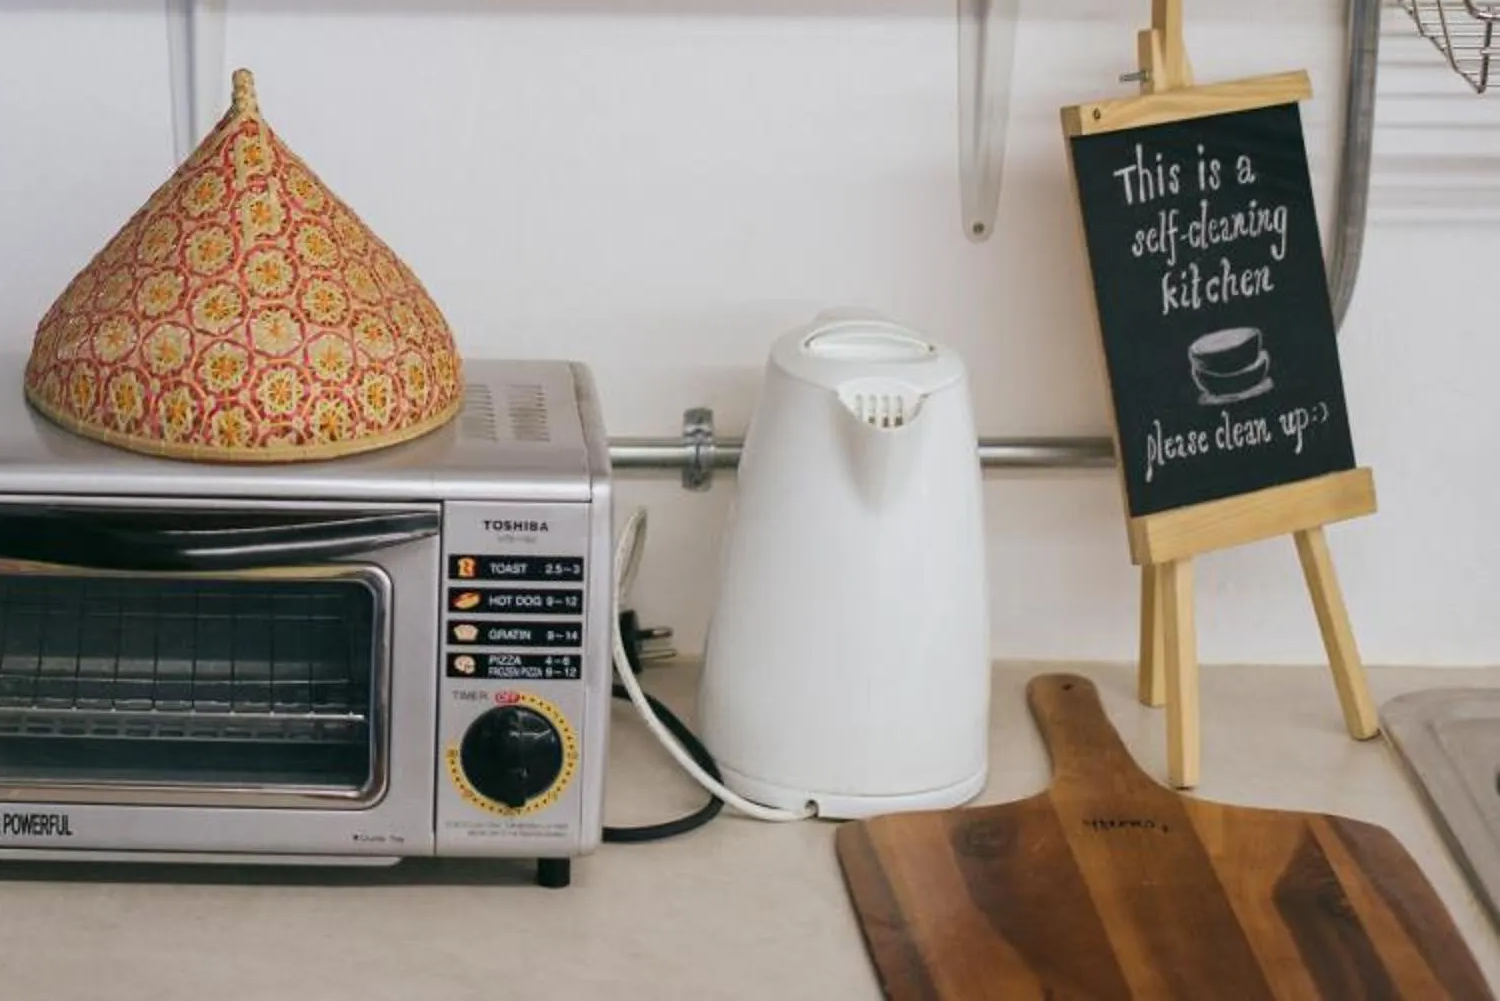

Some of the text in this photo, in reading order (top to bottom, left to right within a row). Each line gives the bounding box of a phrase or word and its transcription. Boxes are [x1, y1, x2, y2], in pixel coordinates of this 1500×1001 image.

[1112, 143, 1257, 205] This is a
[1131, 199, 1288, 266] self-cleaning
[1161, 256, 1275, 316] kitchen
[1145, 419, 1209, 483] please
[1215, 410, 1272, 451] clean
[483, 520, 549, 532] TOSHIBA
[489, 562, 528, 575] TOAST
[489, 594, 512, 607] HOT
[515, 594, 542, 607] DOG
[488, 628, 532, 641] GRATIN
[488, 655, 521, 666] PIZZA
[452, 690, 489, 701] TIMER
[3, 813, 73, 836] POWERFUL
